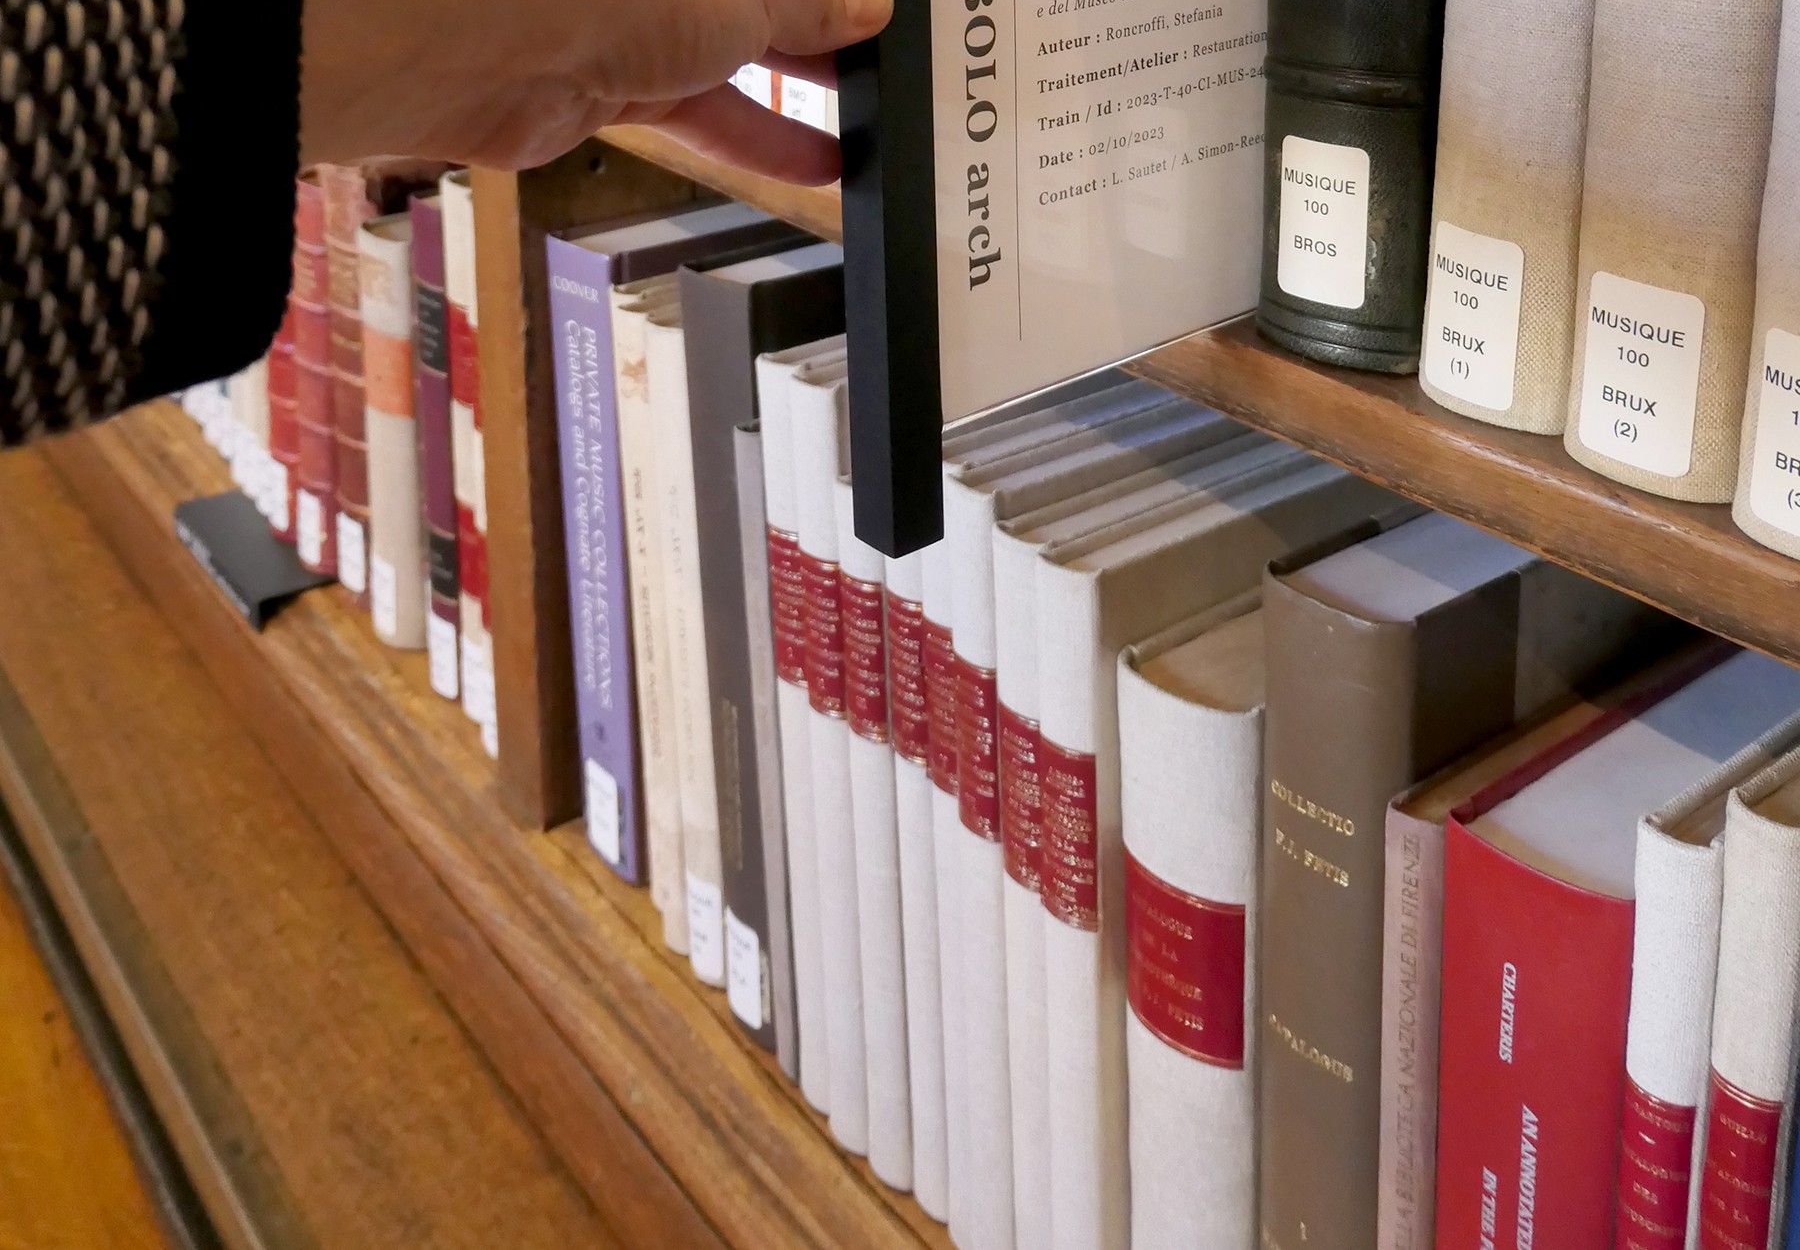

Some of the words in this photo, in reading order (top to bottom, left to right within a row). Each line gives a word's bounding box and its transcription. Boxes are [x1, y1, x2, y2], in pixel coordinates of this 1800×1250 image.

[1036, 7, 1043, 18] e
[1037, 33, 1091, 57] Auteur
[1106, 15, 1169, 41] Roncroffi,
[1174, 4, 1223, 27] Stefania
[1192, 31, 1267, 57] Restauration
[1038, 110, 1081, 132] Train
[1096, 101, 1112, 118] Id
[1038, 151, 1074, 170] Date
[1088, 126, 1165, 156] 02/10/2023
[1038, 179, 1098, 206] Contact
[1128, 159, 1167, 181] Sautet
[1180, 152, 1193, 166] A.
[1284, 167, 1356, 196] MUSIQUE
[1303, 199, 1329, 216] 100
[966, 161, 1002, 291] arch
[1293, 234, 1337, 257] BROS
[553, 274, 600, 303] COOVER
[1436, 253, 1509, 292] MUSIQUE
[1453, 290, 1479, 310] 100
[1442, 326, 1486, 355] BRUX
[1591, 306, 1686, 348] MUSIQUE
[564, 318, 584, 419] Catalogs
[1450, 359, 1470, 380] (1)
[1616, 345, 1650, 368] 100
[583, 325, 602, 432] PRIVATE
[1601, 384, 1658, 418] BRUX
[1613, 418, 1638, 443] (2)
[573, 424, 589, 472] and
[589, 437, 606, 526] MUSIC
[1499, 961, 1518, 1065] CHARTERIS
[1522, 1102, 1539, 1140] AN
[1483, 1165, 1498, 1198] IN
[1481, 1193, 1497, 1239] THE
